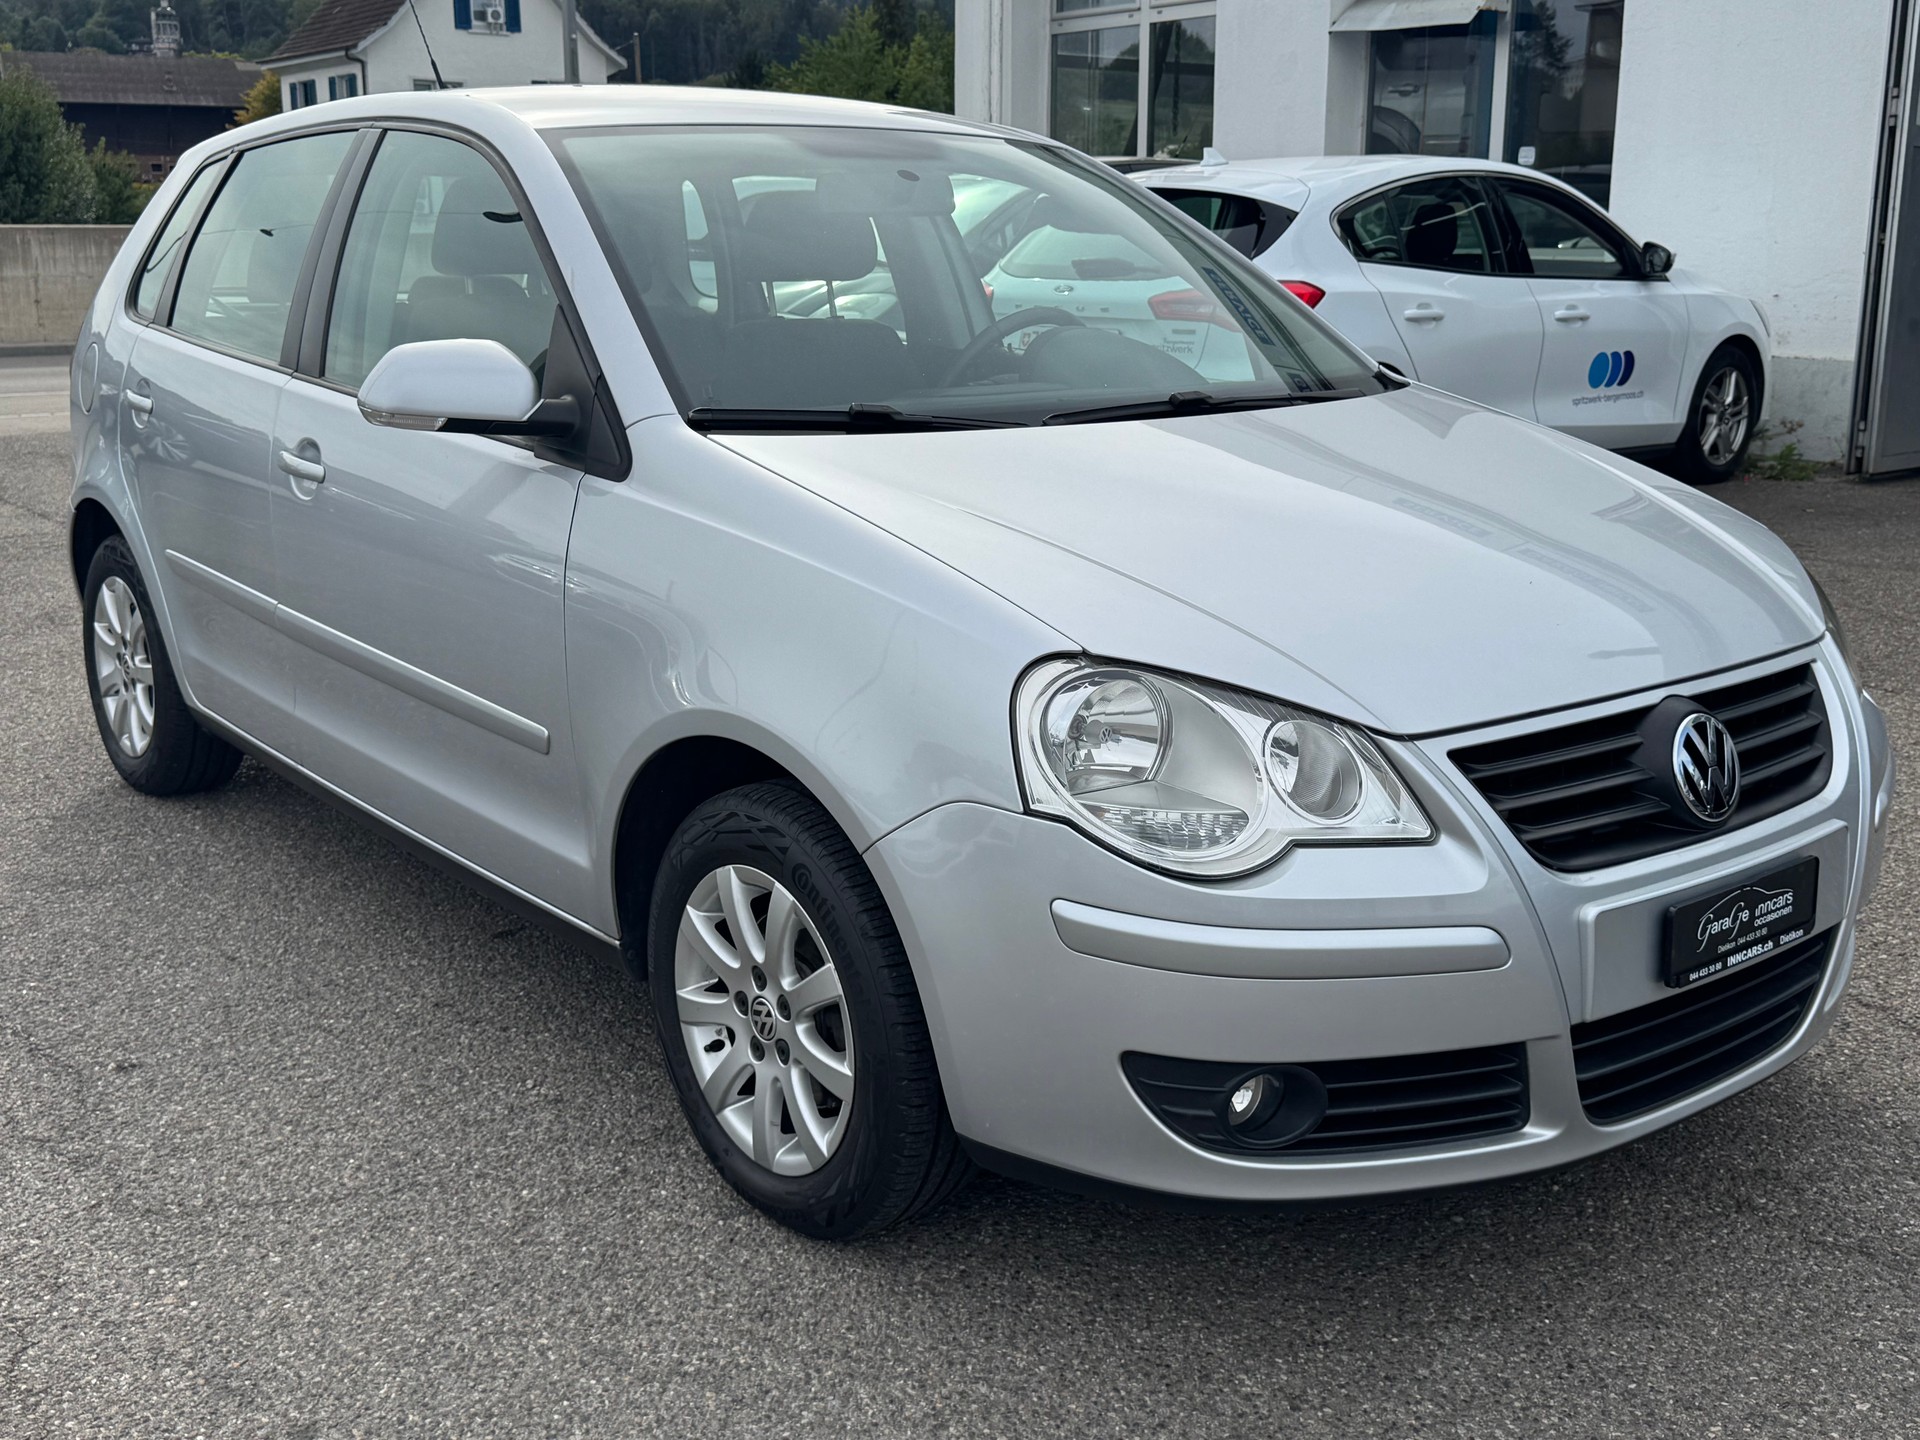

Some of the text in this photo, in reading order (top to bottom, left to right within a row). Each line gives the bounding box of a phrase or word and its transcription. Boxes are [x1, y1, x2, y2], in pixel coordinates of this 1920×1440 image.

[1754, 905, 1793, 927] occasionen
[1755, 892, 1794, 917] inncars
[1689, 971, 1699, 981] 044
[1699, 967, 1708, 977] 433
[1708, 964, 1715, 974] 30
[1727, 940, 1774, 967] INNCARS.ch
[1779, 929, 1804, 945] Dietikon
